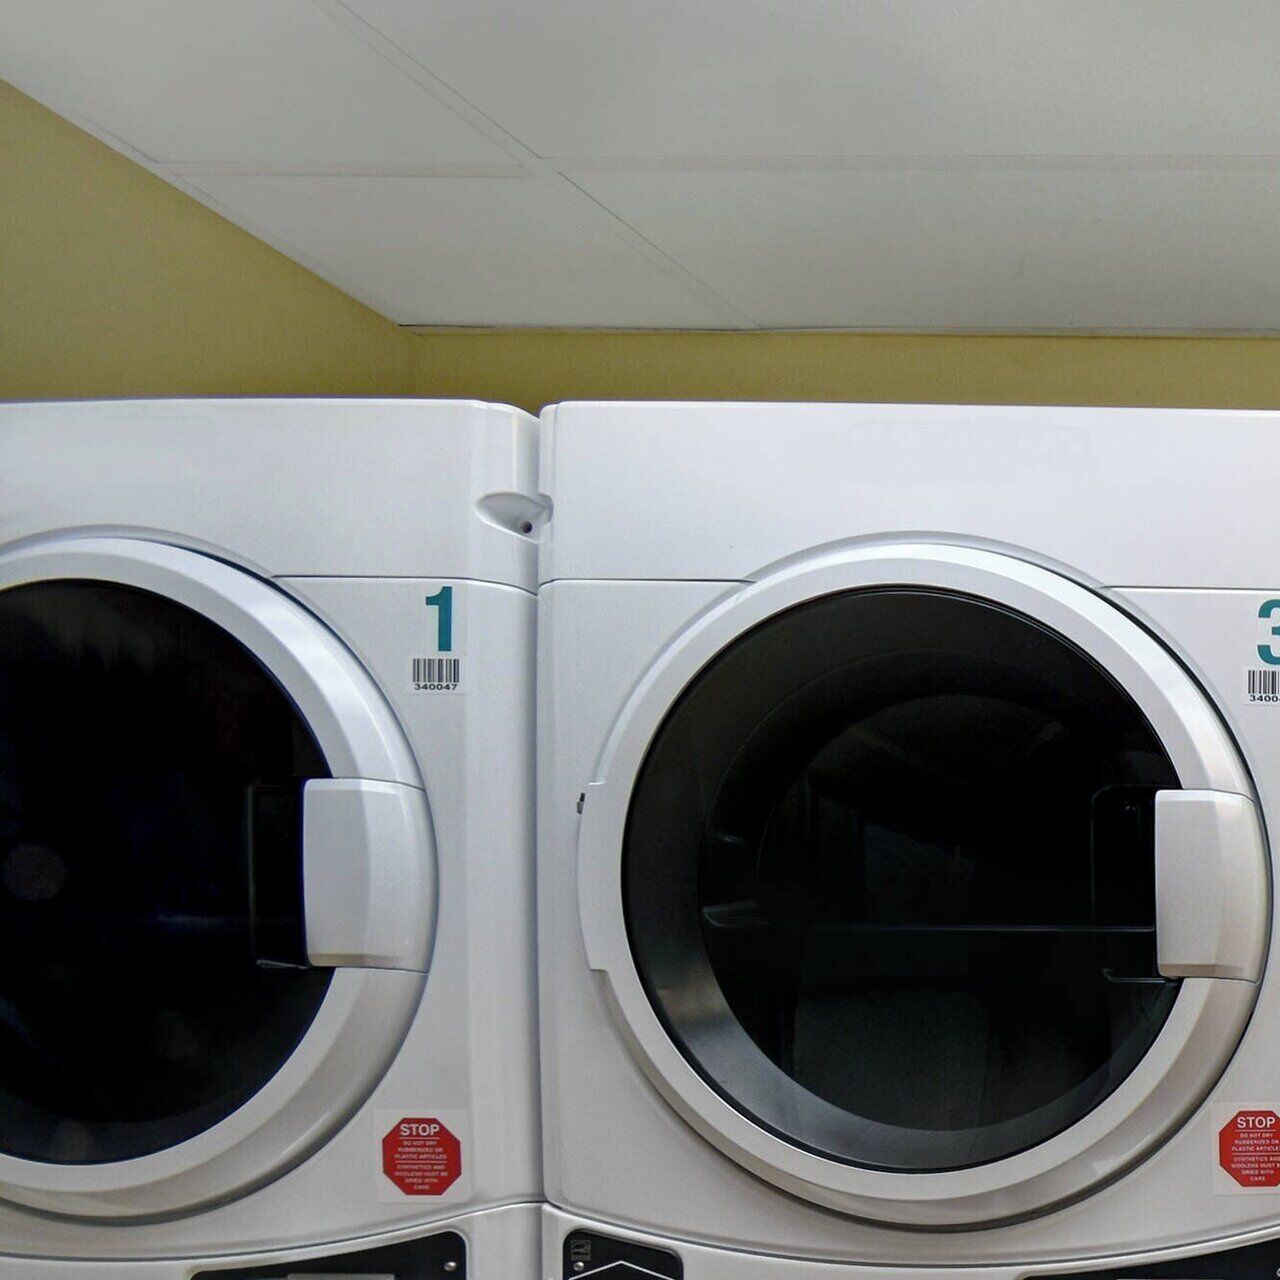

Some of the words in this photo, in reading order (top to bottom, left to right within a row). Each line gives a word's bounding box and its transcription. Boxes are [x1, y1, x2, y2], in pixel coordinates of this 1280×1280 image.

[425, 586, 452, 652] 1
[414, 683, 458, 691] 340047
[1237, 1116, 1275, 1128] STOP
[400, 1123, 439, 1136] STOP
